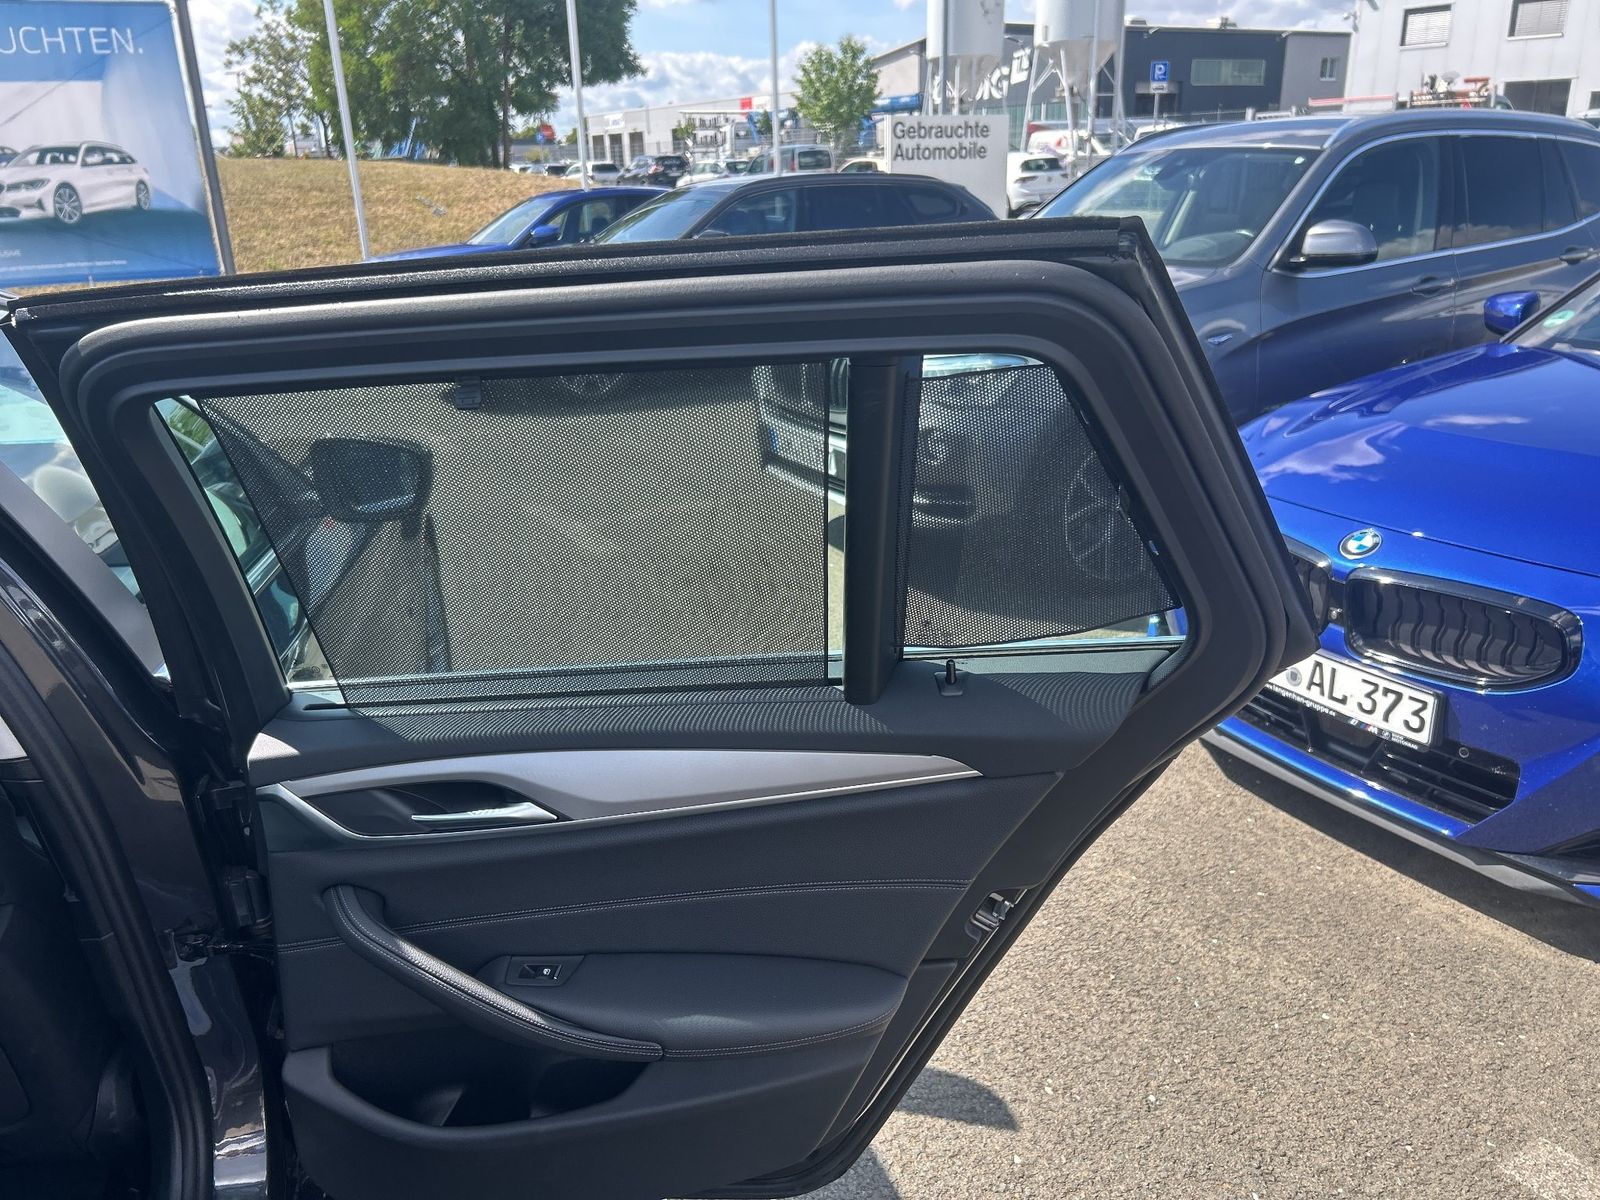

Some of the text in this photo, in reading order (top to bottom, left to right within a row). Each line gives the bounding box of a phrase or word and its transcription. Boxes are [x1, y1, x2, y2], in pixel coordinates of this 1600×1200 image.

[0, 26, 144, 55] UCHTEN.
[893, 120, 991, 140] Gebrauchte
[894, 142, 988, 161] Automobile
[1306, 660, 1428, 734] AL 373
